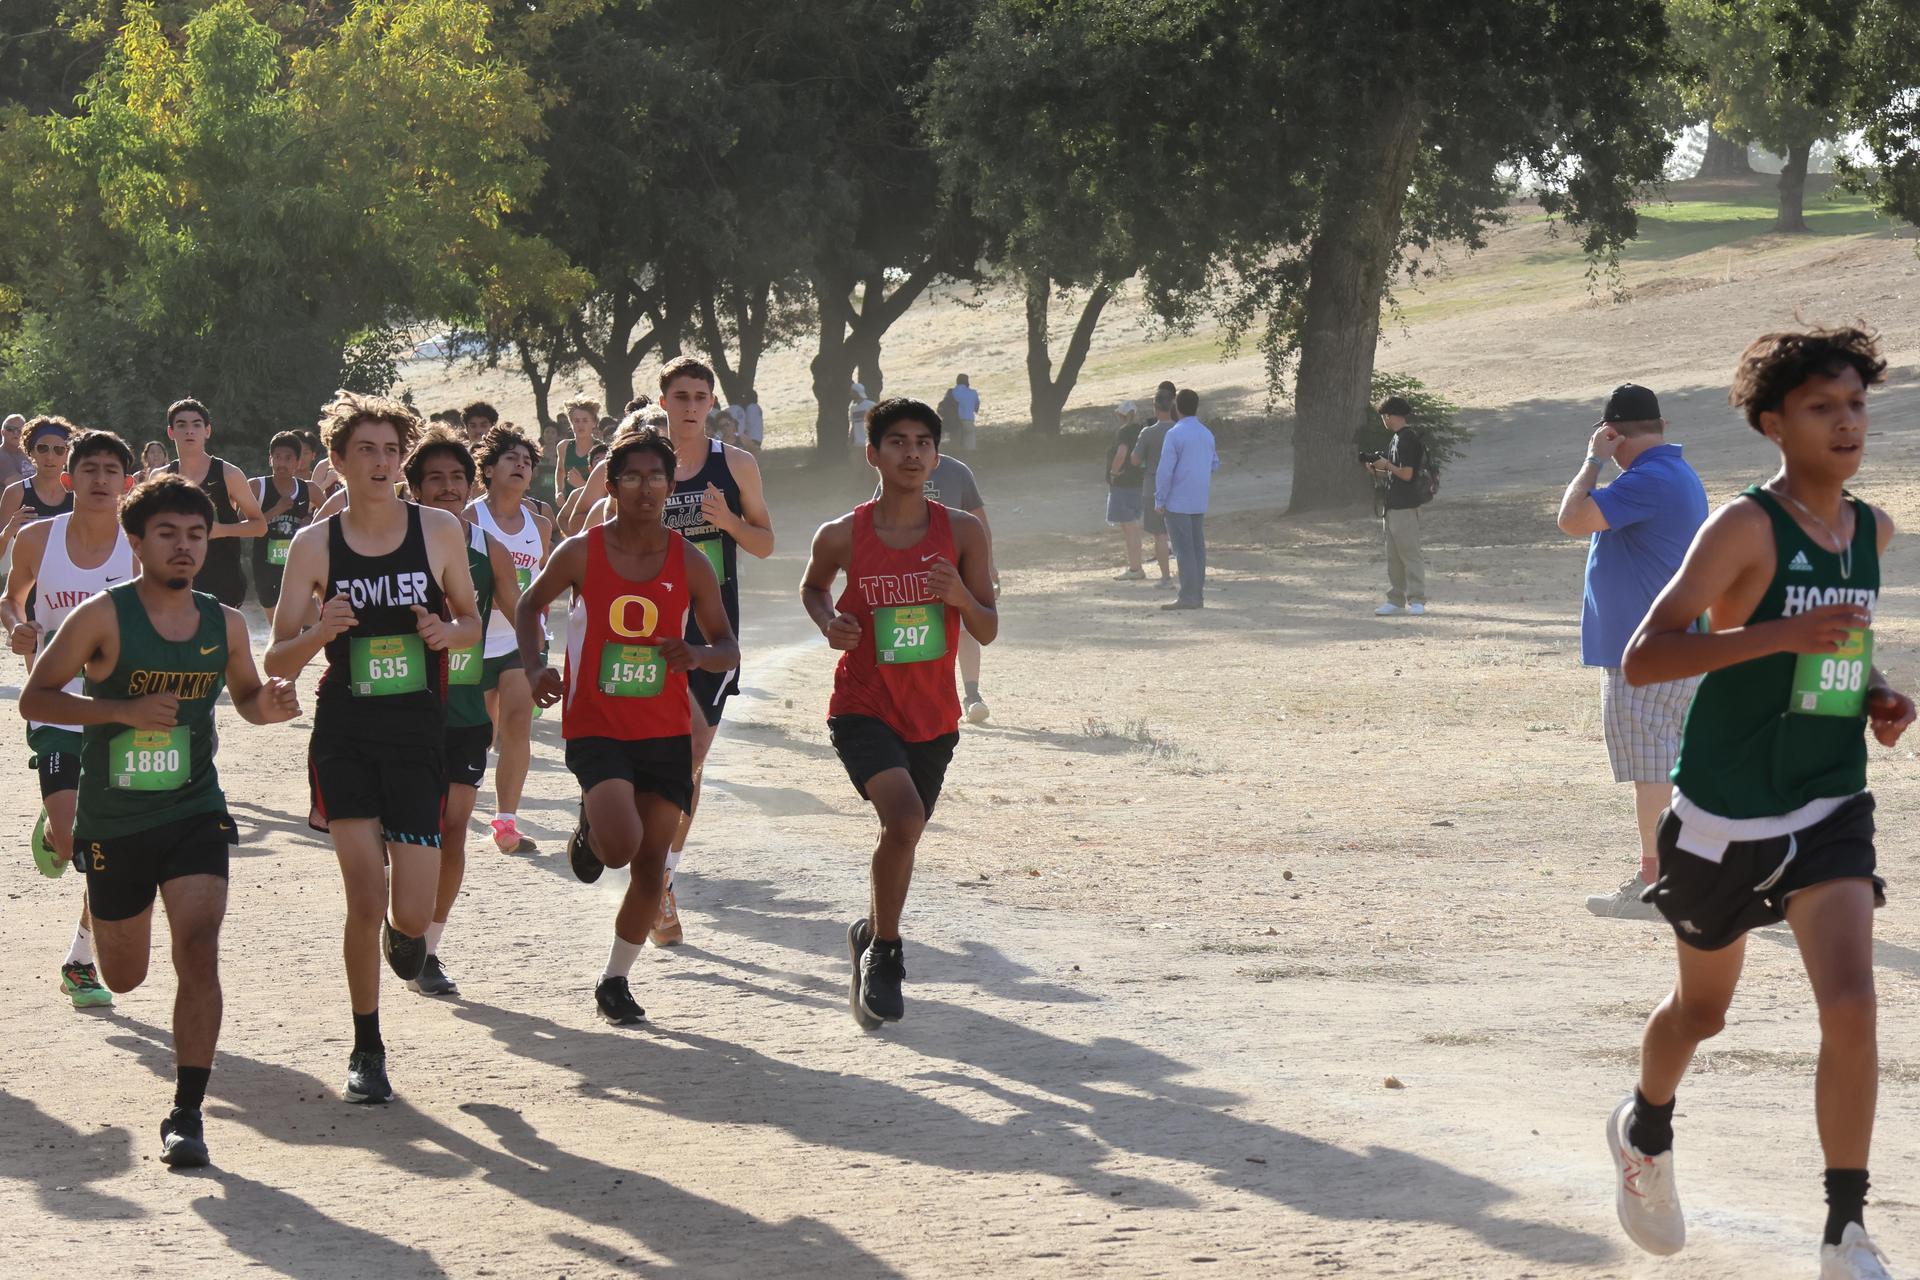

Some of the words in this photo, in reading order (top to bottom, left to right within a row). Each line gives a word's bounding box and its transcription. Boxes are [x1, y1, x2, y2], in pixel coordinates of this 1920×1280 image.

[510, 552, 538, 568] SAY
[335, 571, 428, 609] FOWLER
[893, 625, 930, 648] 297
[369, 656, 408, 680] 635
[448, 654, 472, 670] 07
[611, 662, 657, 683] 1543
[128, 670, 218, 700] SUMMIT
[1820, 659, 1863, 691] 998
[124, 749, 179, 773] 1880
